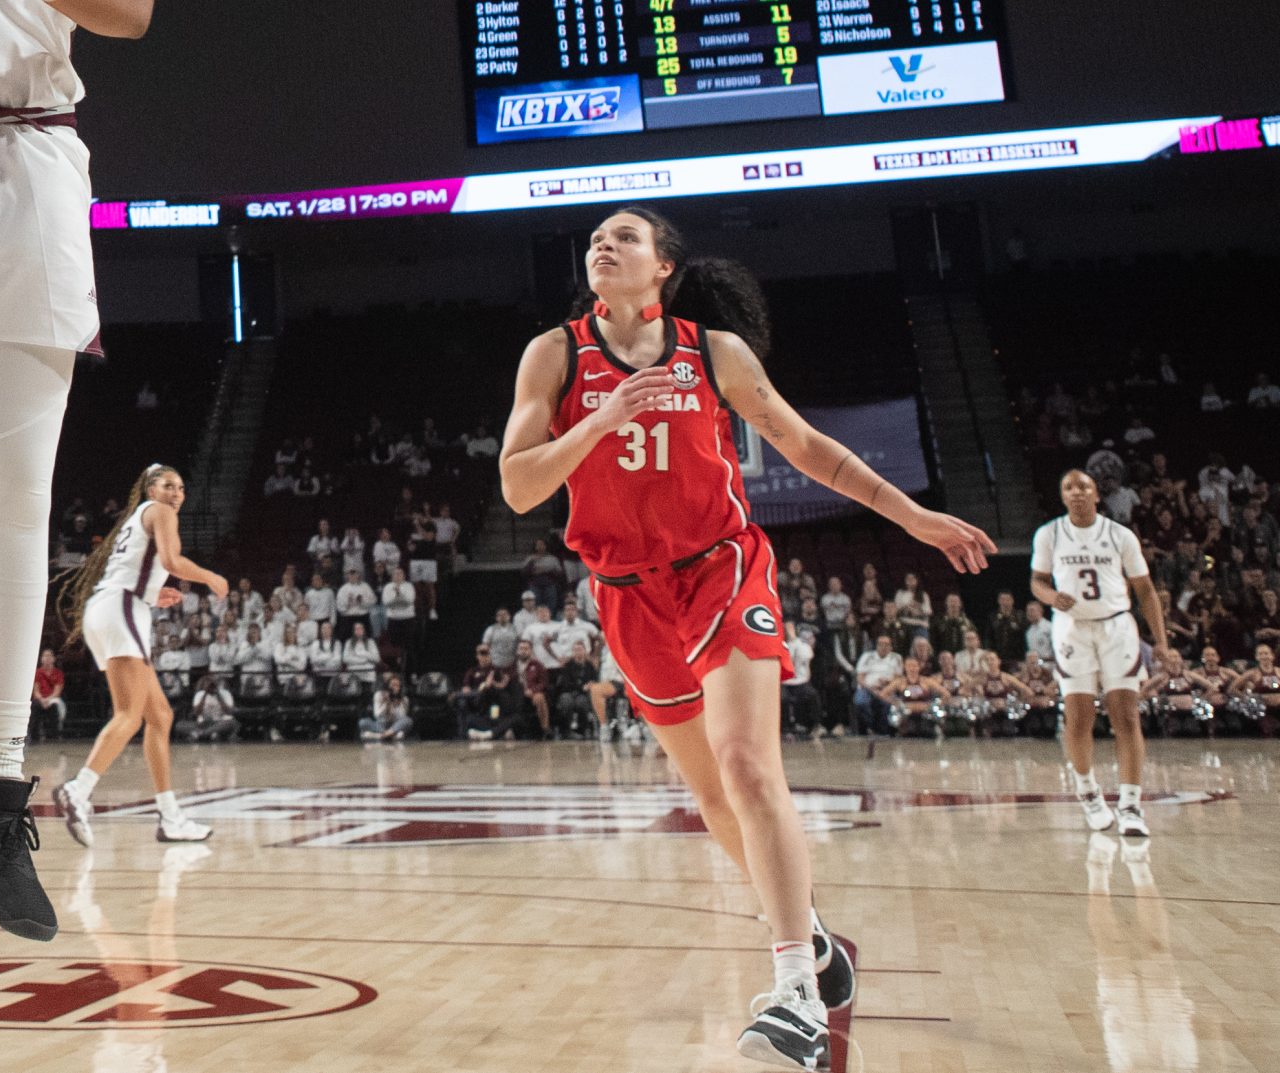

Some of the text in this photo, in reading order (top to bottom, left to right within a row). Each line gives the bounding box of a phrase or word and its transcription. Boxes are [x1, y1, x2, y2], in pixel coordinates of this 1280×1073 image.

[476, 3, 484, 15] 2
[485, 0, 518, 15] Barker
[478, 17, 486, 30] 3
[486, 14, 519, 30] Hylton
[595, 6, 603, 18] 0
[615, 4, 623, 16] 0
[703, 12, 740, 26] ASSISTS
[771, 4, 792, 23] 11
[818, 2, 962, 28] 31 Warren 1
[478, 18, 624, 43] 4 Green 1
[699, 32, 750, 47] TURNOVERS
[776, 26, 790, 44] 5
[820, 30, 833, 44] 35
[834, 27, 891, 43] Nicholson
[934, 20, 942, 33] 4
[975, 16, 983, 30] 1
[476, 46, 488, 60] 23
[489, 44, 518, 58] Green
[598, 36, 606, 48] 0
[618, 34, 625, 46] 1
[476, 62, 488, 76] 32
[490, 61, 518, 76] Patty
[580, 53, 588, 66] 4
[657, 46, 798, 76] 25 TOTAL REBOUNDS 19
[664, 78, 678, 96] 5
[715, 75, 761, 88] REBOUNDS
[781, 68, 794, 85] 7
[877, 88, 945, 104] Valero
[501, 94, 586, 127] KBTX
[877, 154, 920, 169] TEXAS
[950, 147, 989, 164] MEN'S
[991, 140, 1075, 160] BASKETBALL
[563, 177, 603, 194] MAN
[605, 171, 670, 191] MOBILE
[129, 204, 220, 227] VANDERBILT
[246, 188, 448, 218] SAT. 1/28 7:30 PM
[582, 391, 701, 411] GEGIA
[617, 421, 669, 471] 31
[1060, 555, 1091, 566] TEXAS
[1078, 569, 1101, 600] 3
